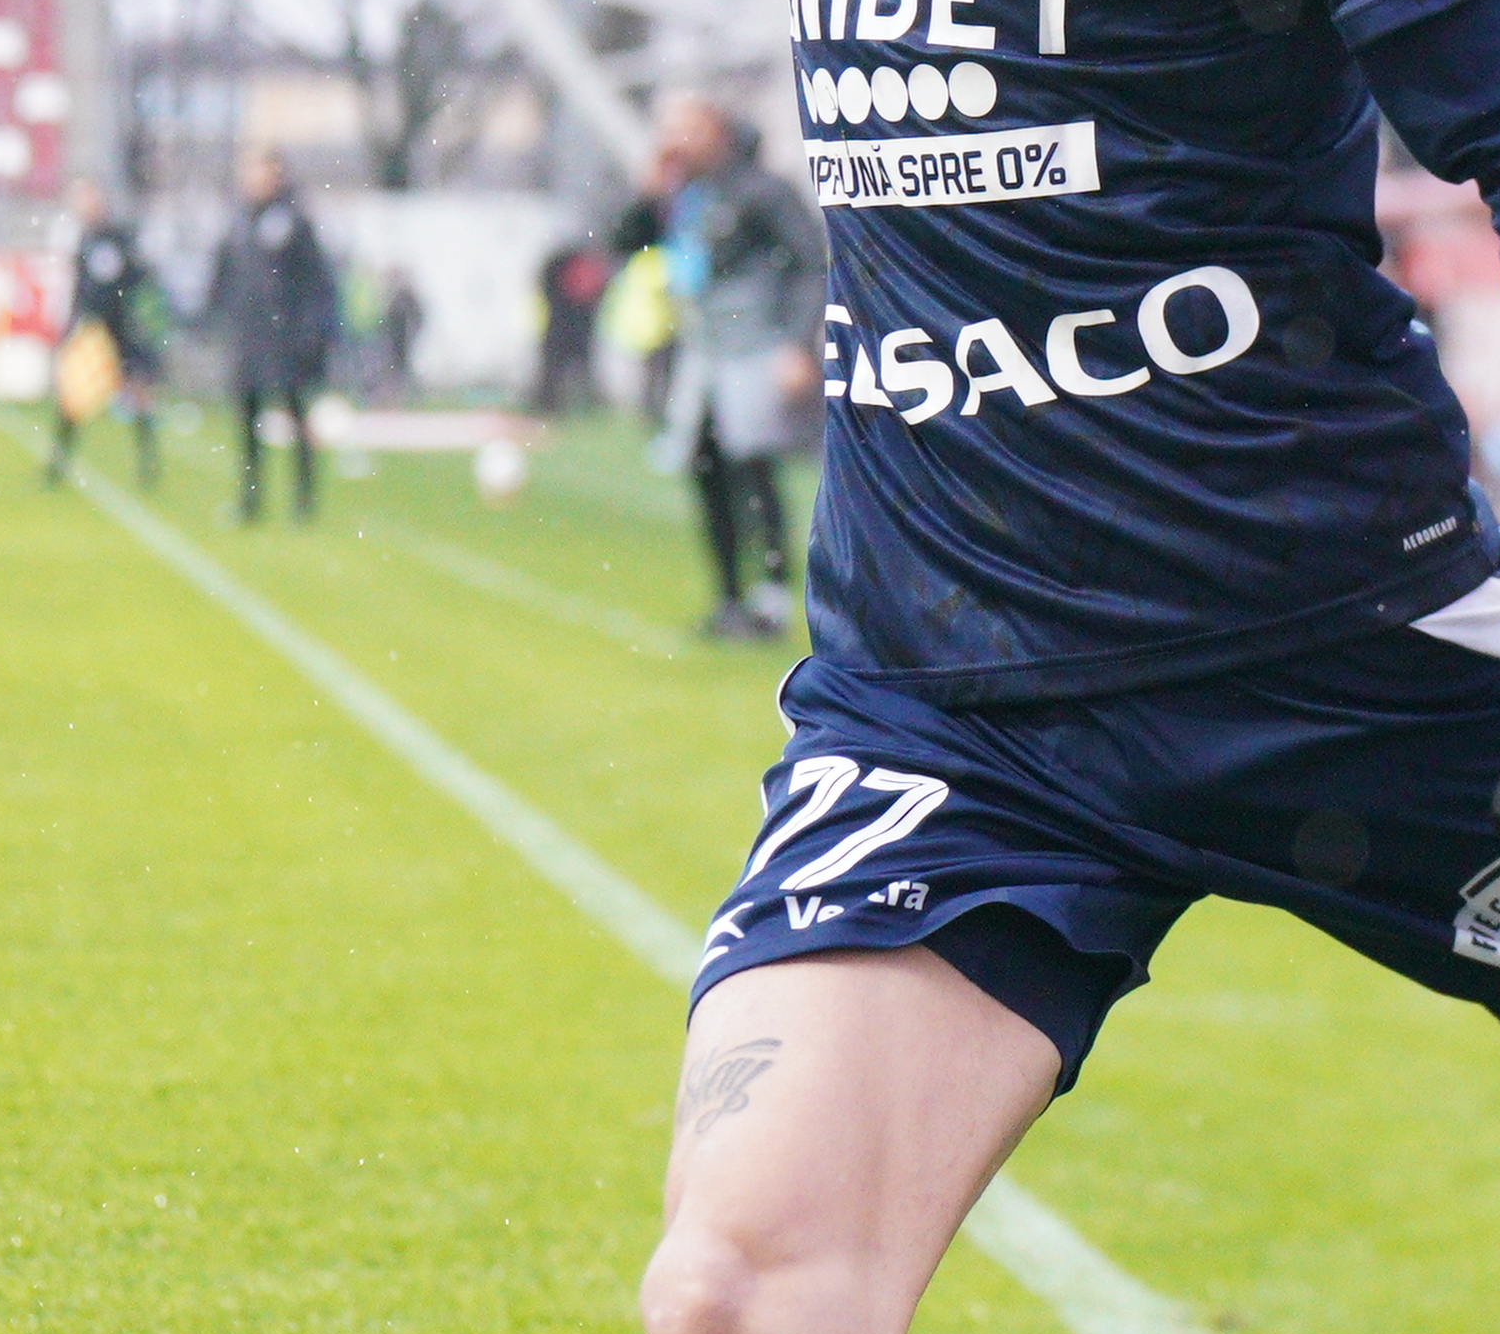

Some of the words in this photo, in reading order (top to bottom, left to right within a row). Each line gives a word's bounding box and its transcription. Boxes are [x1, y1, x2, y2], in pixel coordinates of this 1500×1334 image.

[898, 151, 987, 197] SPRE
[996, 142, 1067, 190] 0%
[739, 755, 949, 891] 77
